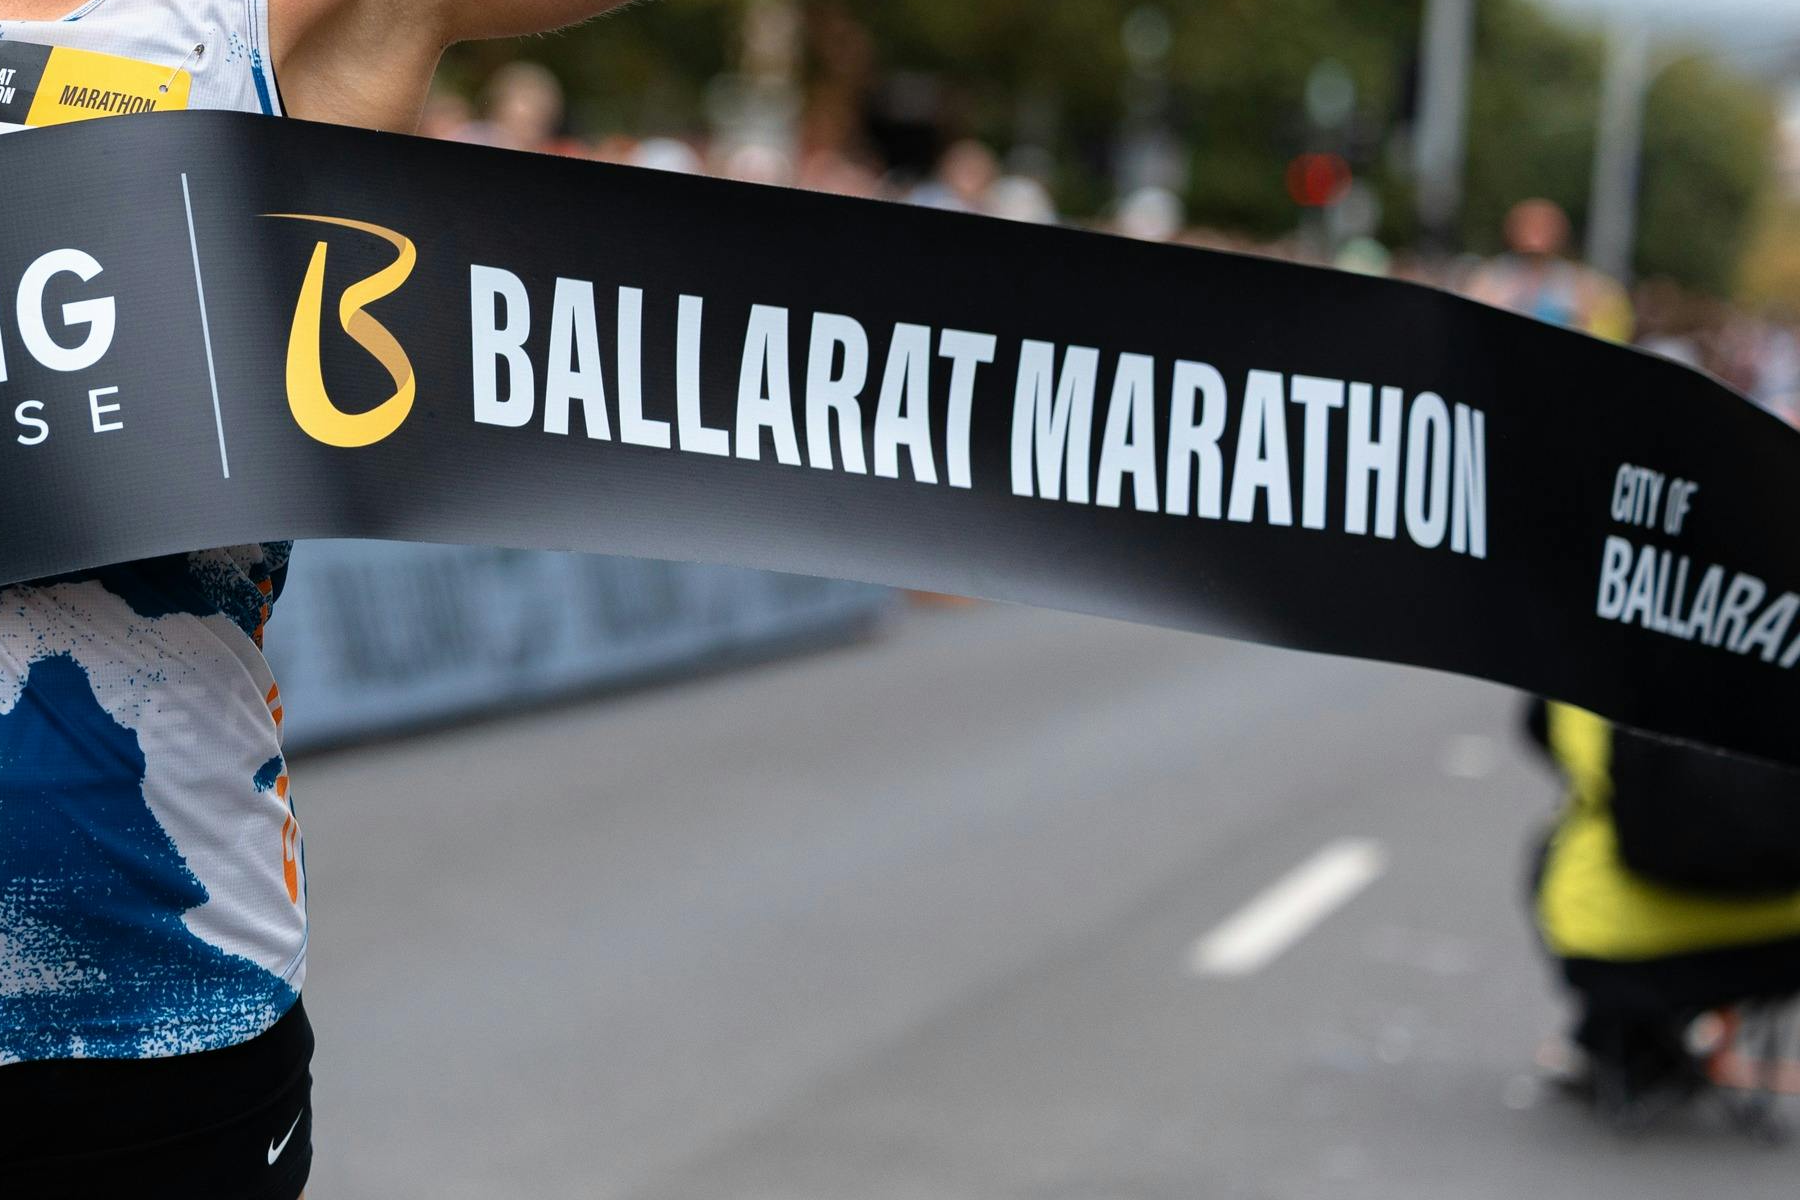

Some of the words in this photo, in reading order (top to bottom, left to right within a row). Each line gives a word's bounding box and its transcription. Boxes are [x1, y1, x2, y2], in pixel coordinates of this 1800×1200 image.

[59, 85, 157, 115] MARATHON
[470, 263, 998, 489] BALLARAT
[1011, 338, 1488, 560] MARATHON
[1611, 462, 1666, 530] CITY
[1664, 476, 1699, 537] OF
